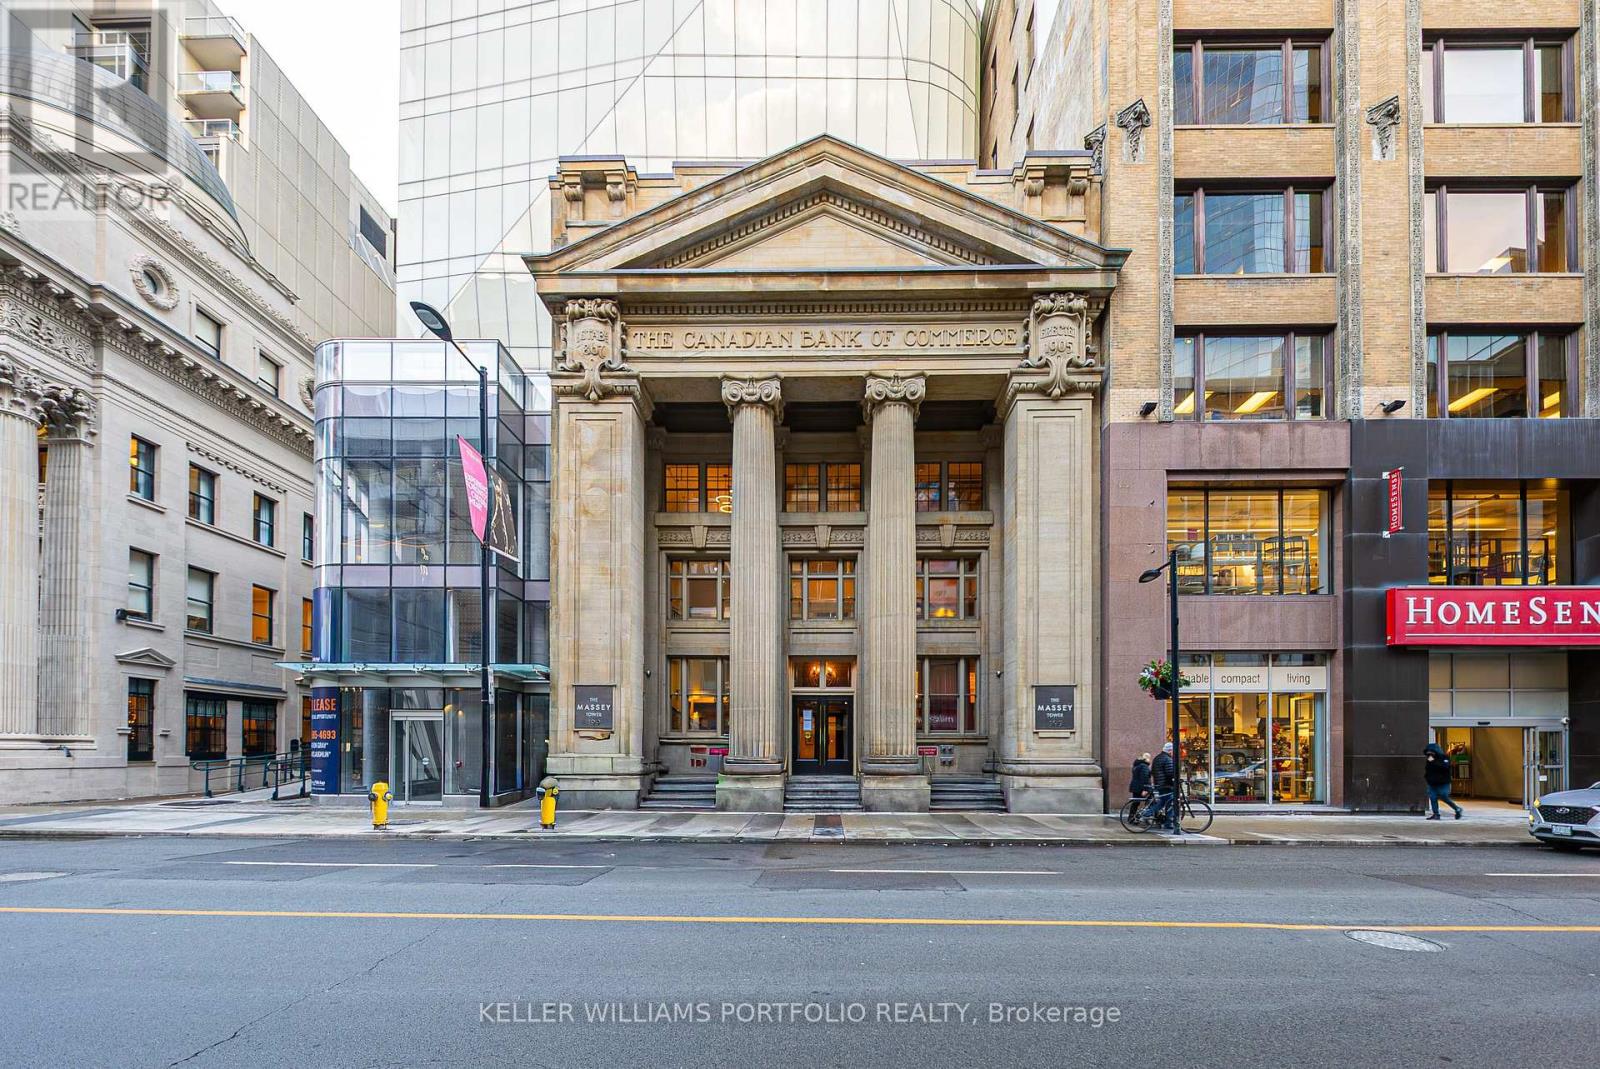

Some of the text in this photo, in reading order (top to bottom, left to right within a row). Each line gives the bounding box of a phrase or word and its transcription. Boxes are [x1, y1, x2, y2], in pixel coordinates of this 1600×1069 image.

[633, 328, 1017, 349] THE CANADIAN BANK OF COMMERCE
[1221, 673, 1260, 685] compact
[1287, 673, 1311, 685] living
[313, 698, 336, 711] LEASE
